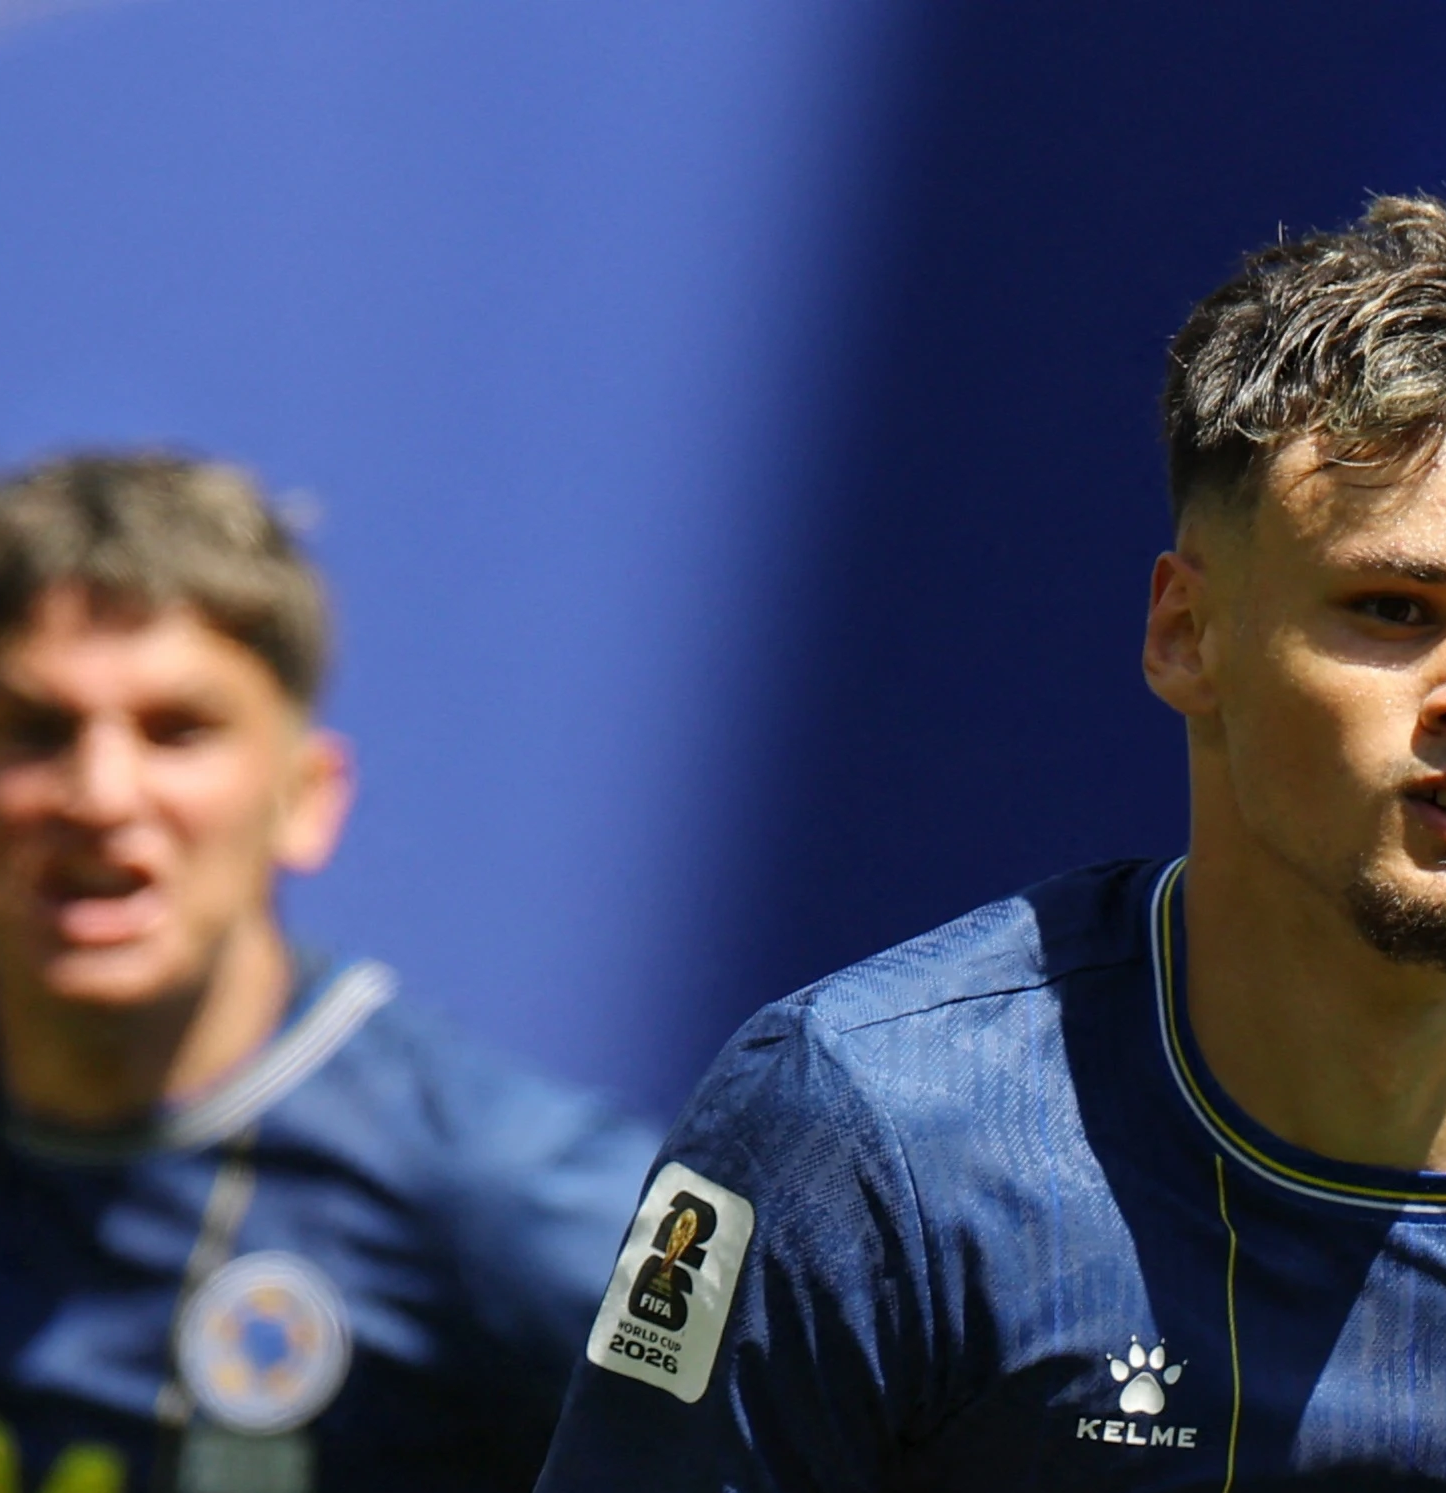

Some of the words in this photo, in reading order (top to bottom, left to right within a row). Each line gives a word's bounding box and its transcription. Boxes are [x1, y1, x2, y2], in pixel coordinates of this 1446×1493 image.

[639, 1292, 672, 1319] FIFA
[618, 1320, 658, 1343] WORLD
[660, 1336, 682, 1352] CUP
[609, 1334, 678, 1375] 2026
[1076, 1417, 1198, 1448] KELME
